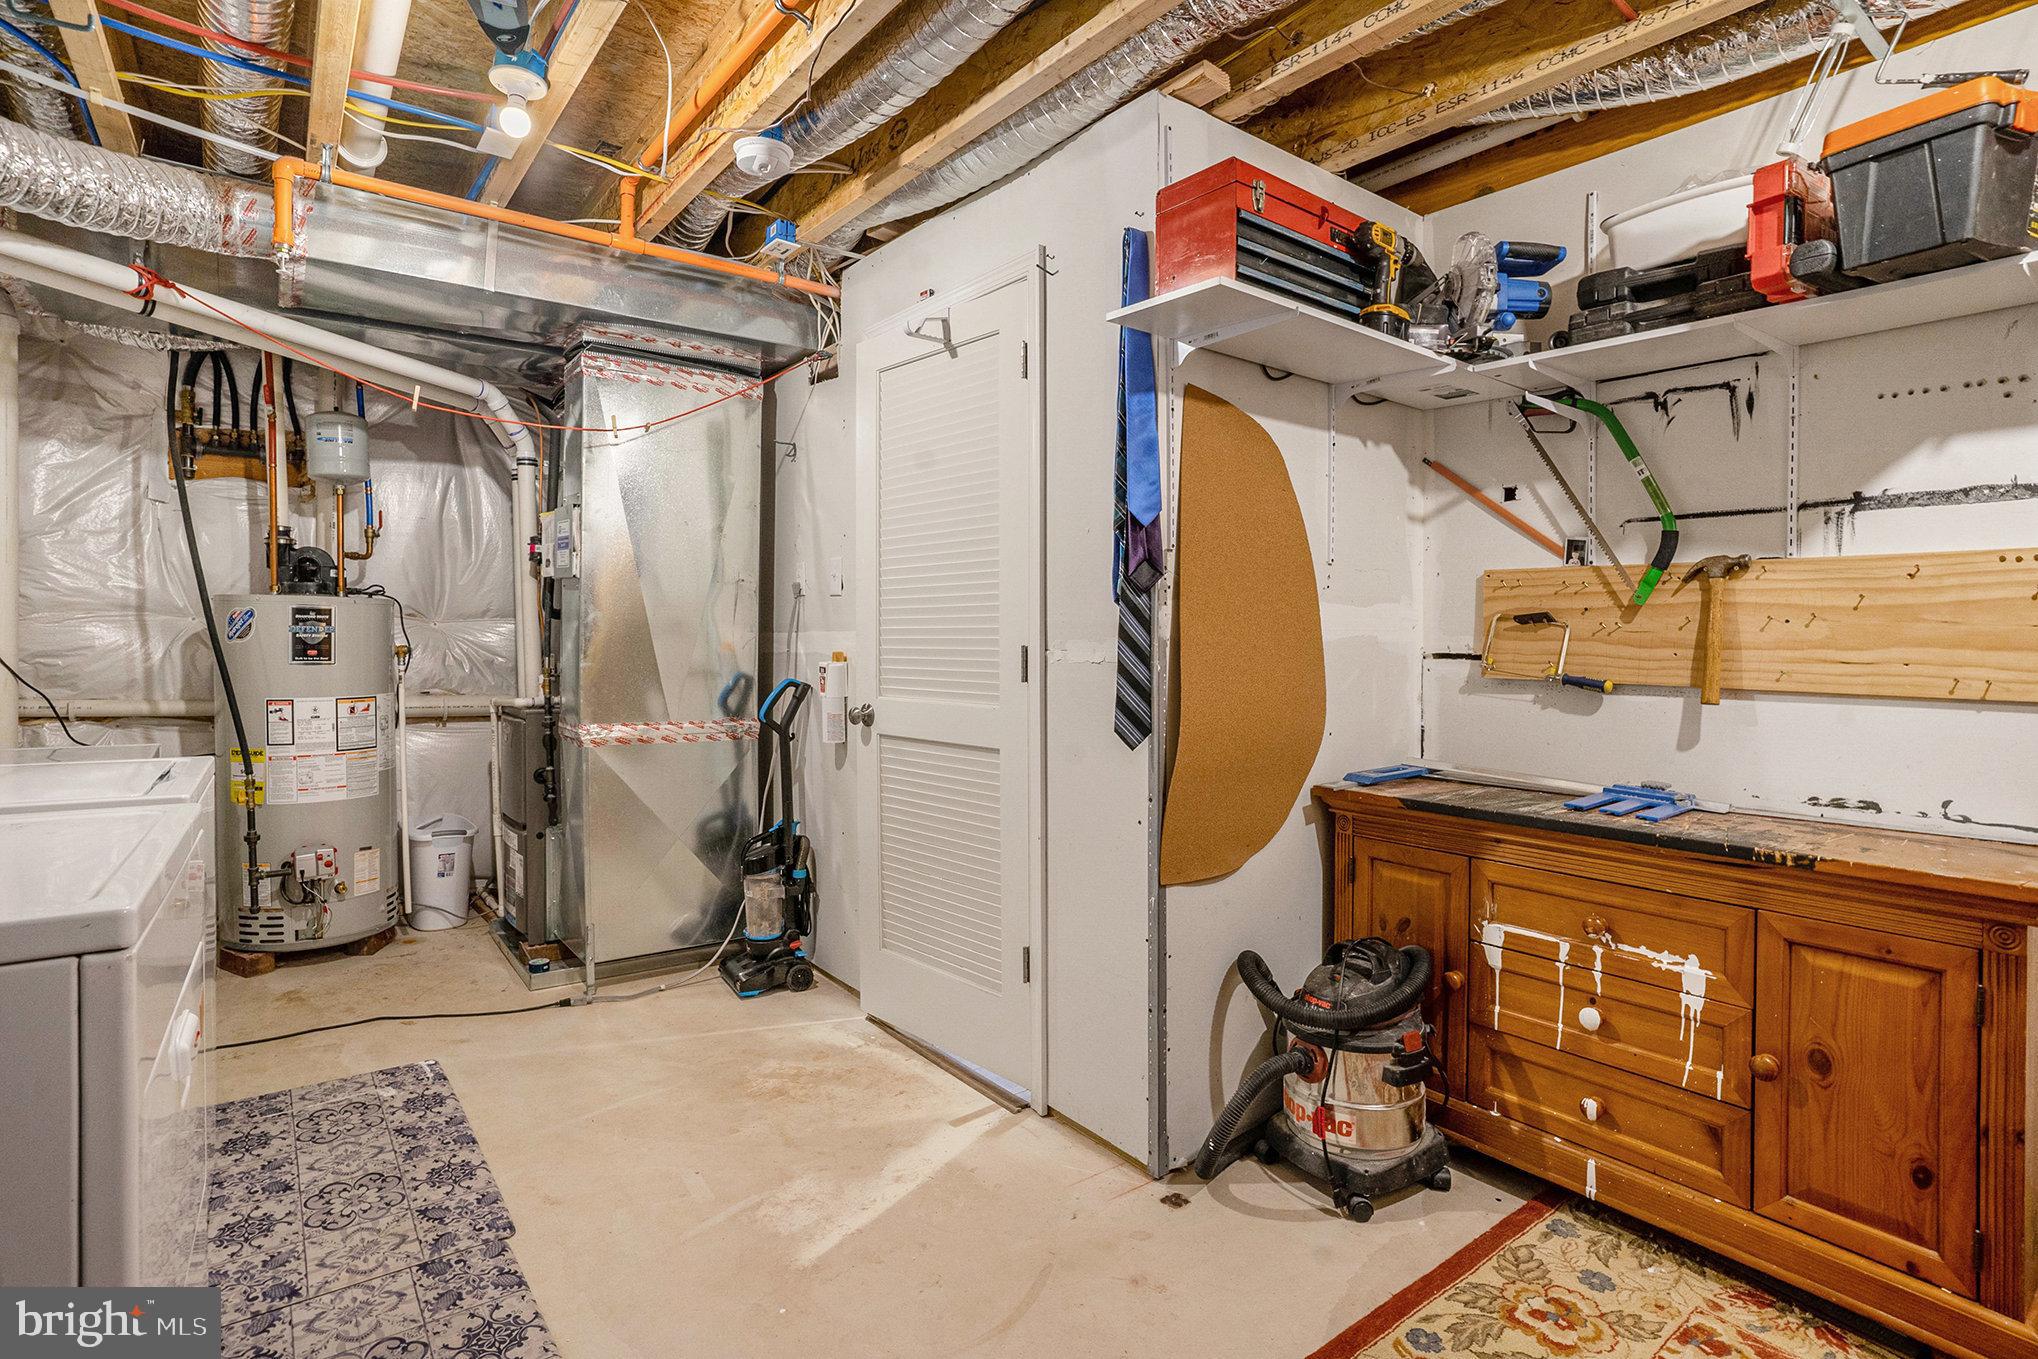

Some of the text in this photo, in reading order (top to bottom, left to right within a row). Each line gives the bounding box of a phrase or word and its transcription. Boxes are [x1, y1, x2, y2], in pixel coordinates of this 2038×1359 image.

[1270, 31, 1353, 78] ESR-1144
[1368, 111, 1426, 142] ICC-ES
[1435, 72, 1525, 115] ESR-1144
[289, 625, 336, 633] DEFENDER
